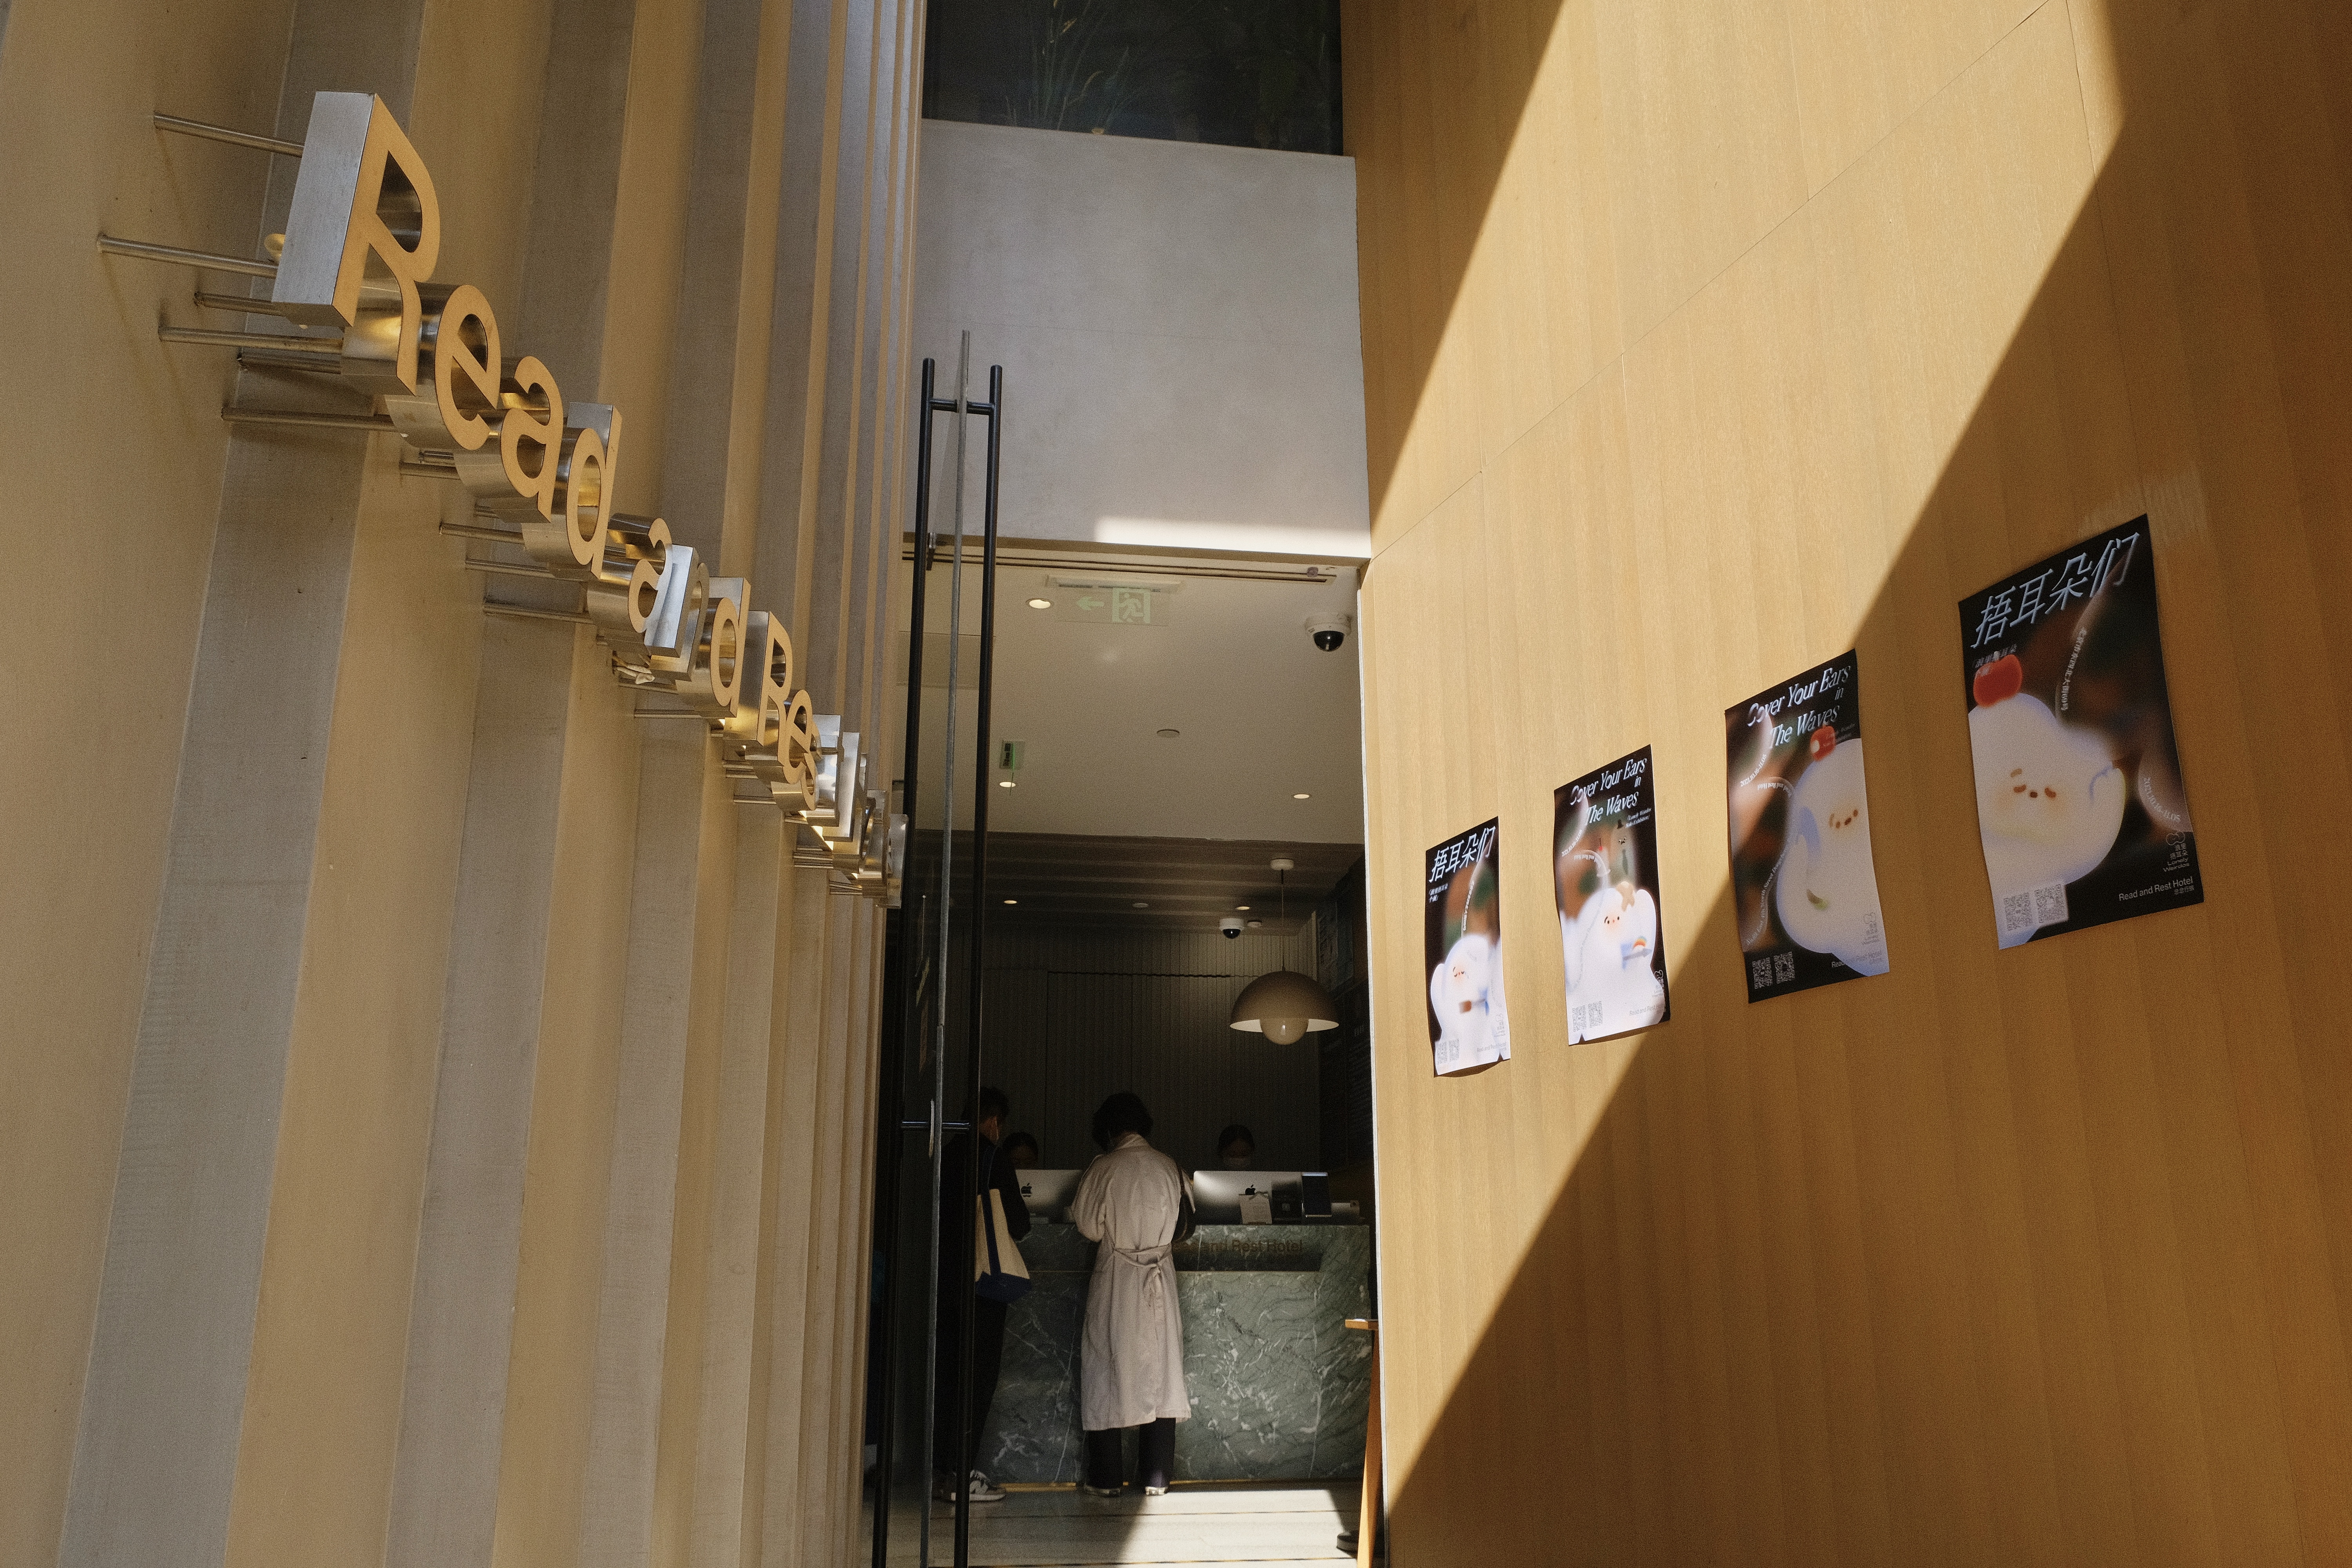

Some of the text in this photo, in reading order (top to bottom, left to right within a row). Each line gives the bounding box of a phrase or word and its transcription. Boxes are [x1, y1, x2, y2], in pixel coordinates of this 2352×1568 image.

[274, 91, 622, 579] Read
[1971, 532, 2140, 649] 捂耳朵们
[1747, 665, 1851, 727] Cover Your Ears
[1834, 686, 1844, 701] in
[1769, 723, 1792, 749] The
[1797, 705, 1840, 737] Waves
[1570, 758, 1647, 806] Cover Your Ears
[1634, 775, 1642, 788] in
[1584, 791, 1639, 826] The Waves
[1428, 826, 1496, 883] 捂耳朵们
[2163, 863, 2190, 873] Weirdos
[2167, 858, 2189, 866] Lonely
[2118, 877, 2193, 901] Read and Rest Hotel
[1231, 1240, 1263, 1252] Rest
[1267, 1239, 1303, 1252] Hotel
